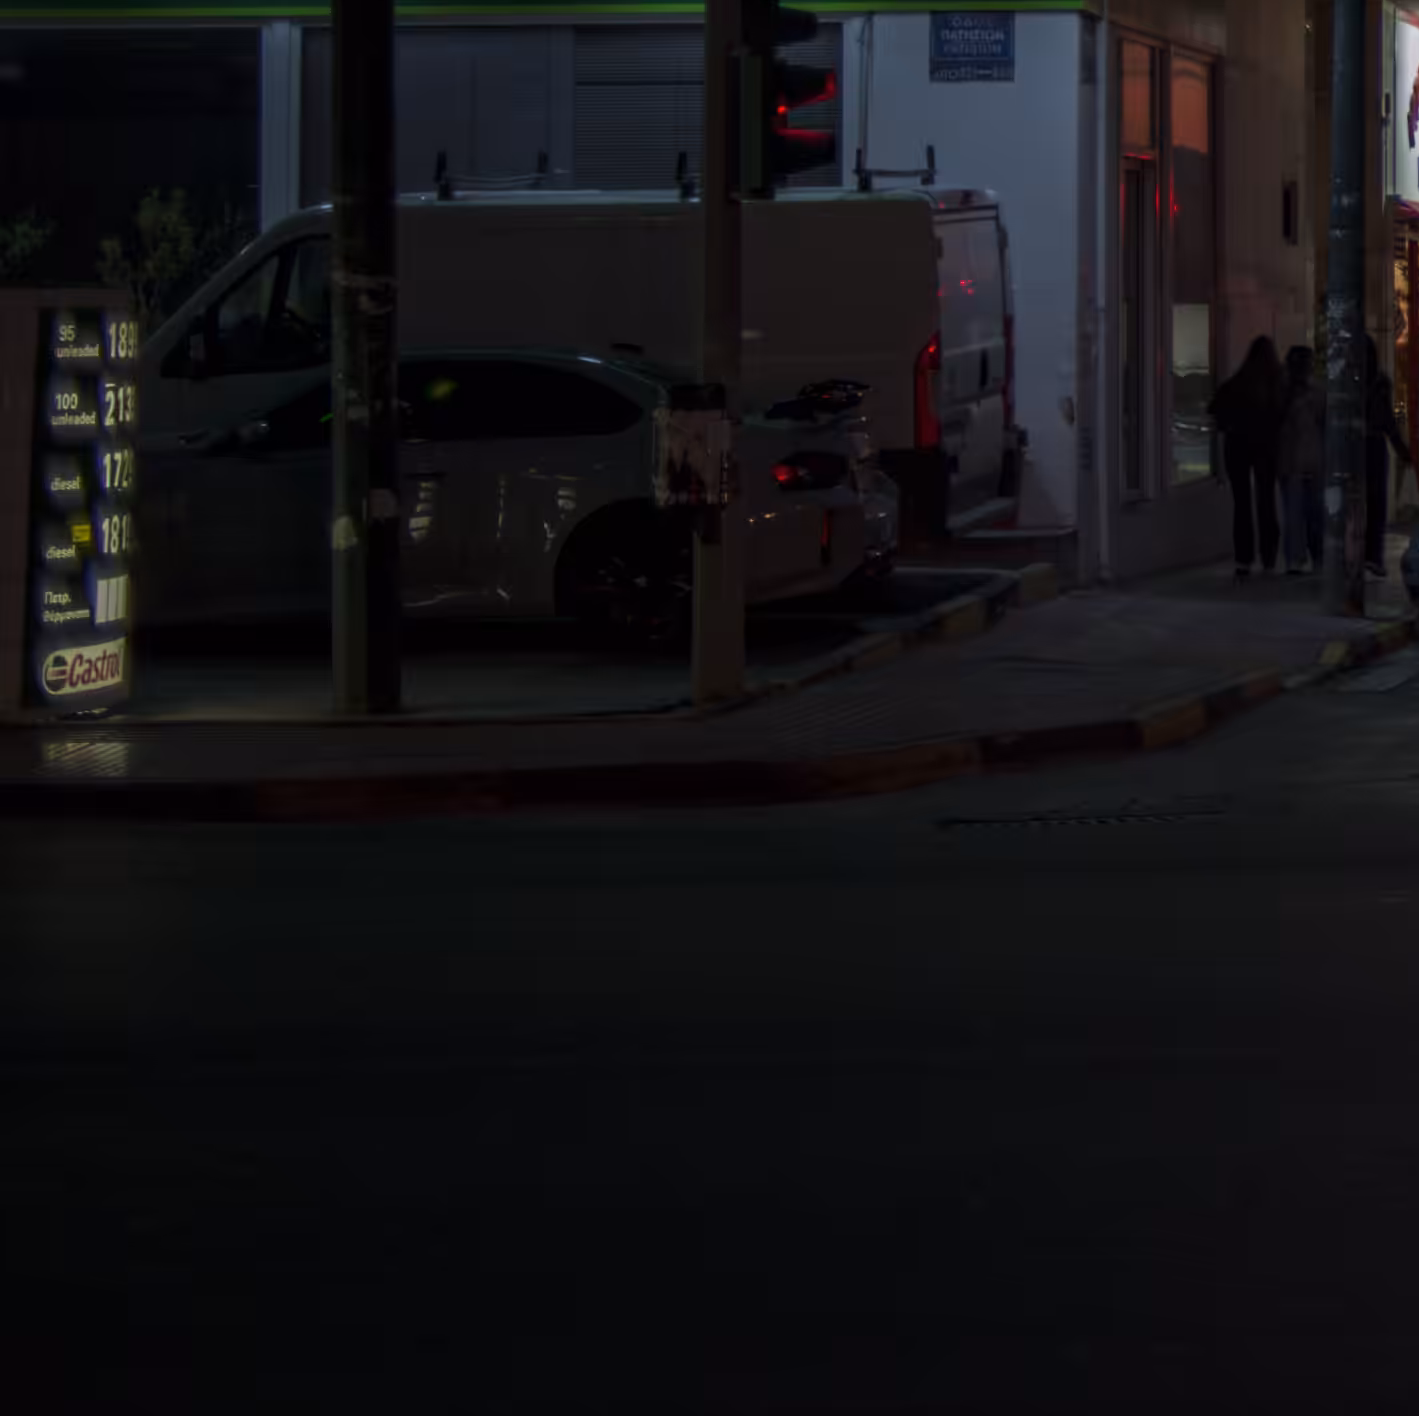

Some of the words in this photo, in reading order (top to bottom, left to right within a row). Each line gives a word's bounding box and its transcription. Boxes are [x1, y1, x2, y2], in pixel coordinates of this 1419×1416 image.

[58, 324, 75, 342] 95
[55, 393, 79, 410] 100
[68, 647, 123, 688] Castrol
